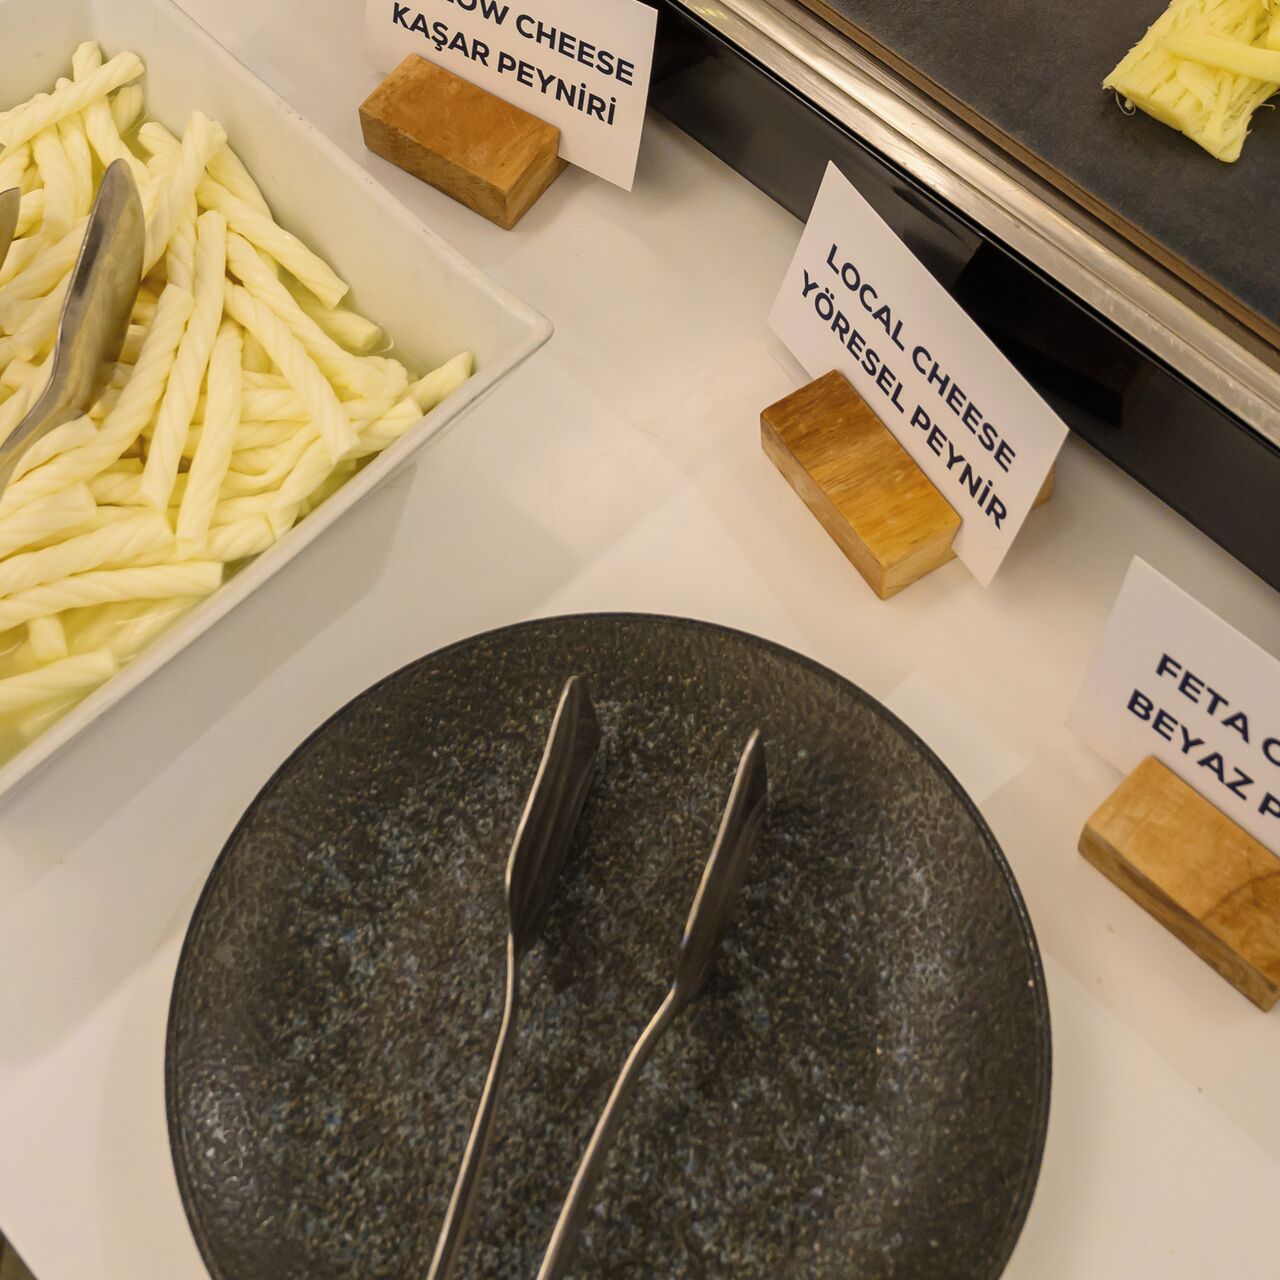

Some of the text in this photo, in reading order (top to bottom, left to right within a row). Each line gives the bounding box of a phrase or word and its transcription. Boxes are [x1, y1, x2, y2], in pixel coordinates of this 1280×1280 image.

[393, 2, 616, 125] KAŞAR PEYNİRİ
[516, 15, 634, 86] CHEESE
[801, 269, 1006, 529] YÖRESEL PEYNİR
[827, 244, 1015, 472] LOCAL CHEESE
[1127, 689, 1254, 799] BEYAZ
[1156, 654, 1249, 743] FETA
